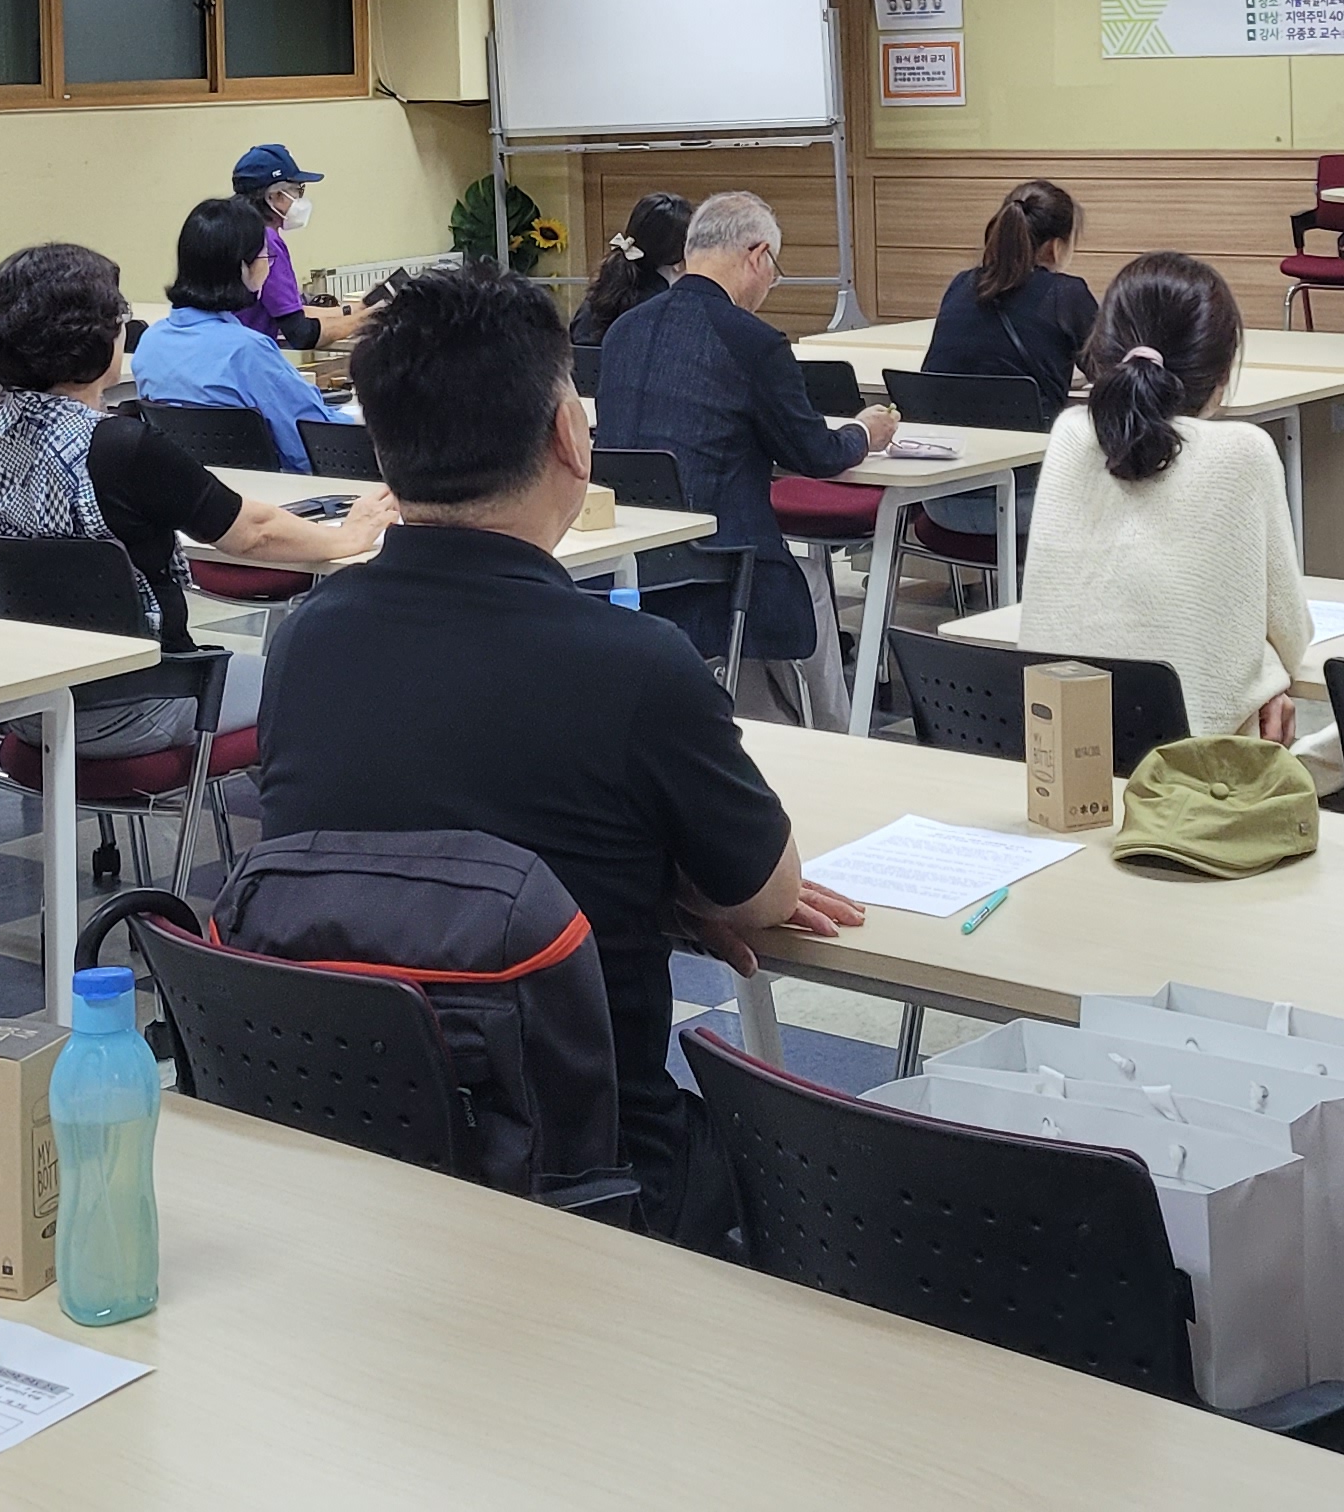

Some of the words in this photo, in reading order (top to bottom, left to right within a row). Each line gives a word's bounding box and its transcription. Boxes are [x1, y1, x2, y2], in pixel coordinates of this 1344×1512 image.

[1285, 10, 1327, 24] 지역주민
[1285, 28, 1317, 41] 유종호
[37, 1139, 51, 1168] MY
